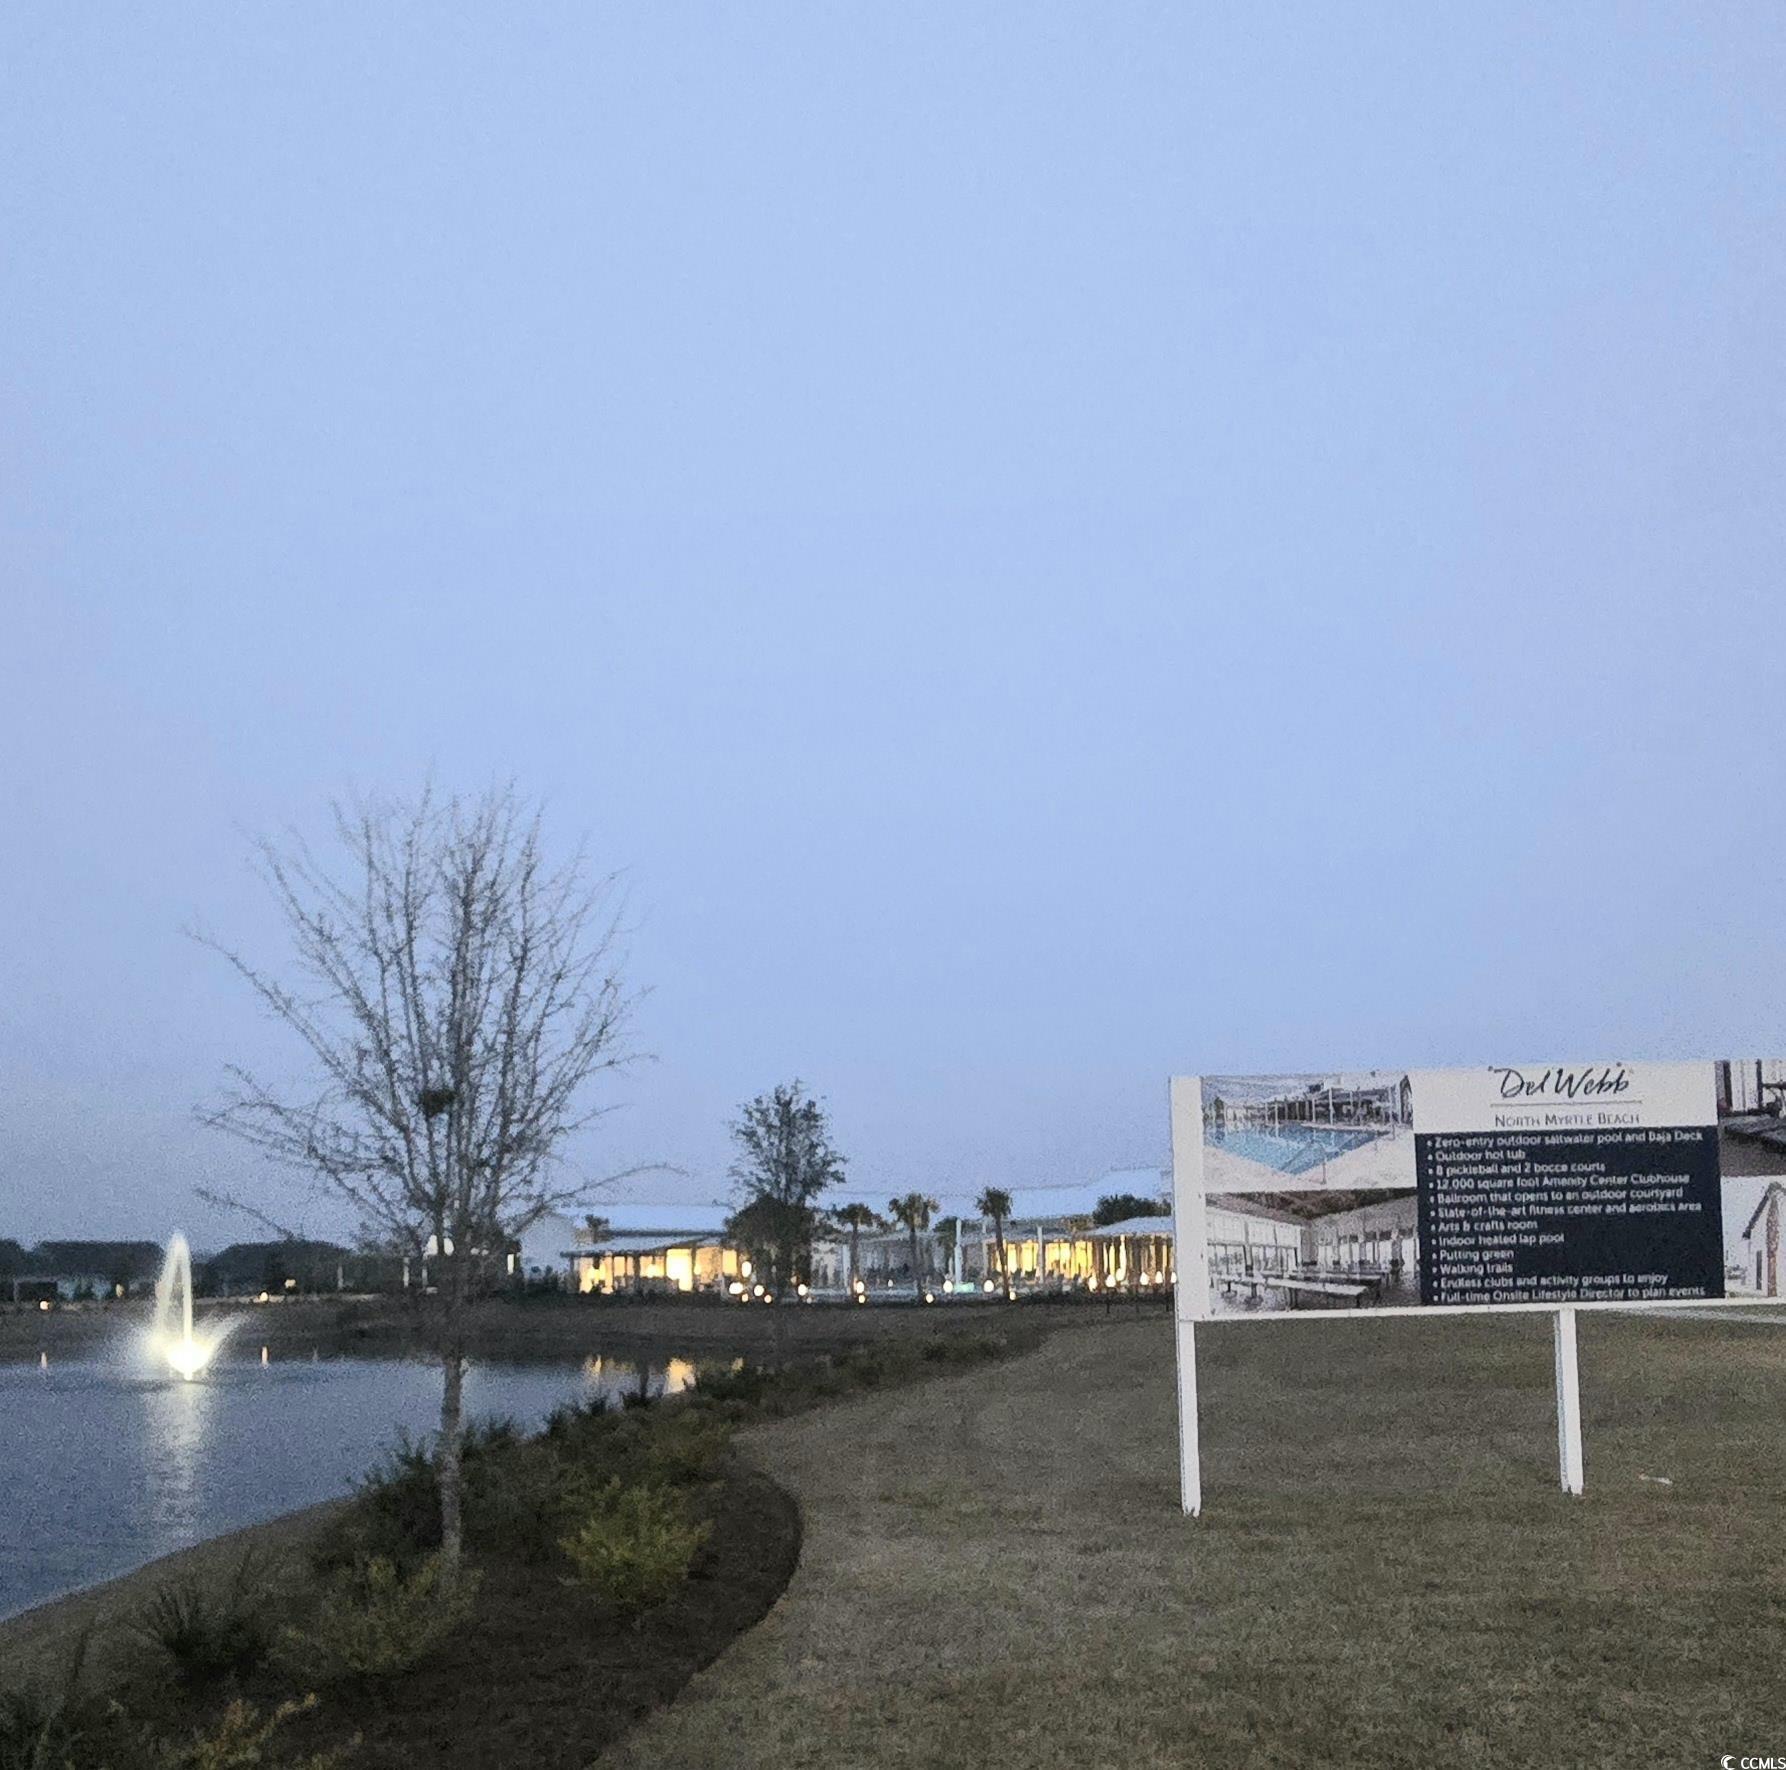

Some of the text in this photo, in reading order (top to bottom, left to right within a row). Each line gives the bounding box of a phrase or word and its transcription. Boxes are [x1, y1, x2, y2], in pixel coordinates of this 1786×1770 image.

[1494, 1068, 1629, 1098] Del Webb
[1495, 1113, 1640, 1127] NORTH MYRTLE BEACH
[1497, 1135, 1541, 1146] outdoor
[1544, 1133, 1594, 1145] saltwater
[1597, 1132, 1622, 1144] pool
[1625, 1131, 1645, 1143] and
[1648, 1131, 1671, 1145] Baja
[1674, 1130, 1703, 1141] Deck
[1435, 1149, 1526, 1161] Outdoor hot tub
[1446, 1163, 1498, 1177] pickleball
[1500, 1163, 1521, 1174] and
[1524, 1162, 1531, 1173] 2
[1534, 1162, 1568, 1173] bocce
[1570, 1161, 1606, 1172] courts
[1478, 1178, 1514, 1190] square
[1517, 1177, 1540, 1187] foot
[1542, 1175, 1587, 1187] Amenity
[1589, 1174, 1628, 1186] Center
[1630, 1174, 1690, 1184] Clubhouse
[1437, 1187, 1683, 1204] Ballroom that opens to an outdoor courtyard
[1529, 1205, 1564, 1216] fitness
[1567, 1204, 1602, 1215] center
[1605, 1203, 1626, 1213] and
[1628, 1202, 1676, 1213] aerobics
[1678, 1202, 1702, 1212] area
[1439, 1221, 1460, 1232] Arts
[1473, 1220, 1505, 1232] crafts
[1507, 1220, 1538, 1230] room
[1438, 1233, 1565, 1247] Indoor heated lap pool
[1439, 1249, 1515, 1262] Putting green
[1440, 1262, 1514, 1276] Walking trails
[1440, 1273, 1669, 1289] Endless clubs and activity groups to enjoy
[1493, 1291, 1530, 1301] Onsite
[1532, 1289, 1577, 1302] Lifestyle
[1579, 1288, 1625, 1299] Director
[1627, 1287, 1640, 1298] to
[1641, 1287, 1667, 1299] plan
[1668, 1286, 1706, 1297] events
